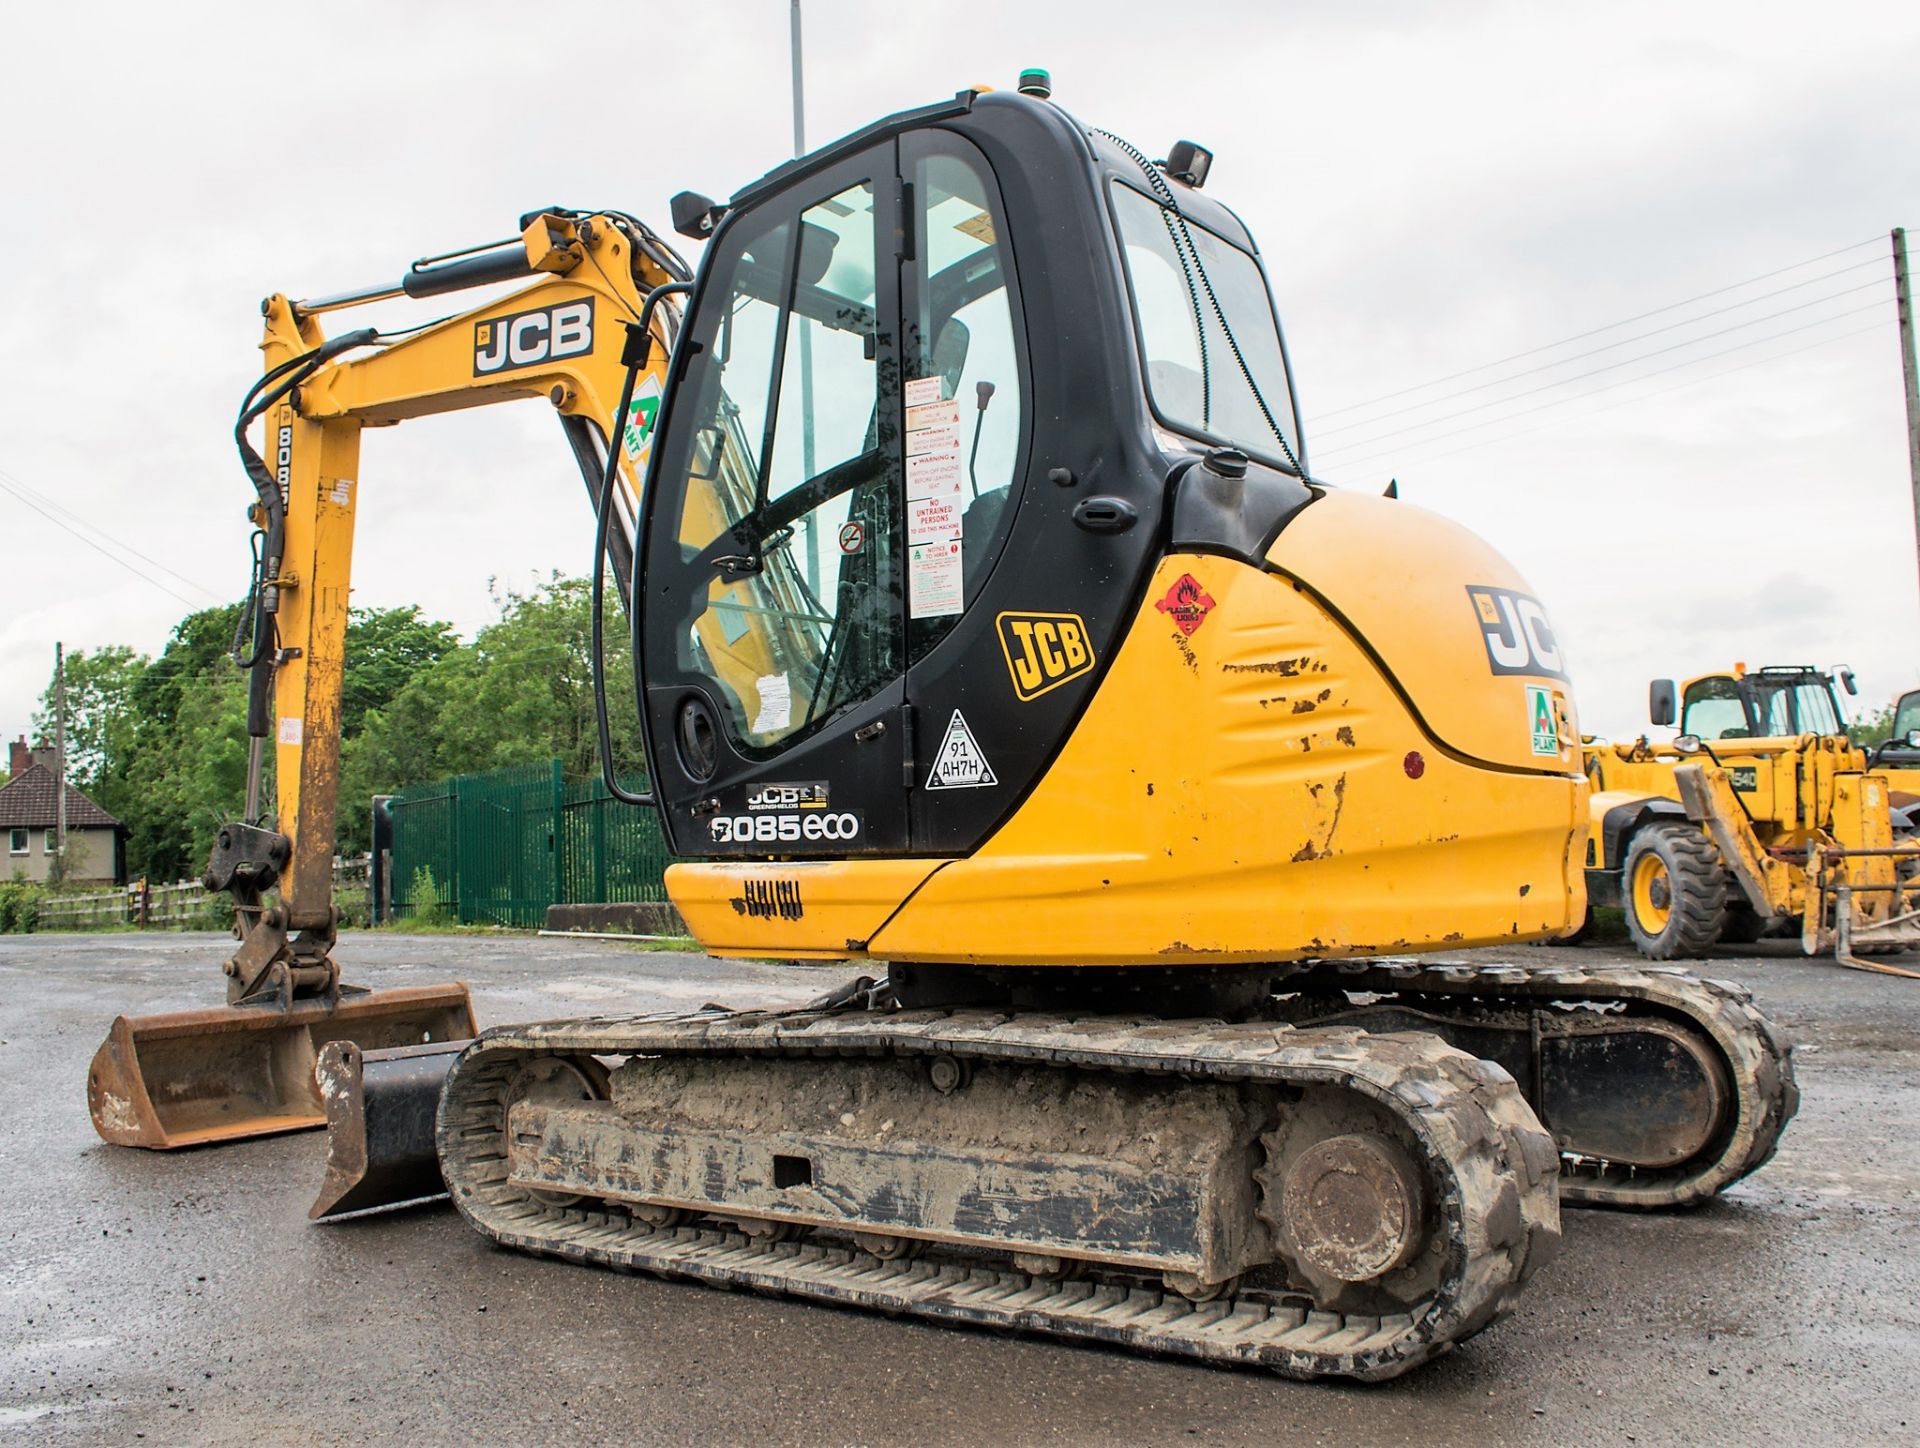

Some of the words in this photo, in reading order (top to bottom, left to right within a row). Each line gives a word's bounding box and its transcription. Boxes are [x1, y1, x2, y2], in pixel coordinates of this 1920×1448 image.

[476, 303, 592, 372] JCB
[919, 454, 949, 463] WARNING
[916, 505, 953, 518] UNTRAINED
[920, 514, 949, 525] PERSONS
[1487, 594, 1566, 672] JC
[1010, 621, 1087, 691] JCB
[950, 741, 968, 758] 91
[1533, 736, 1557, 752] PLANT
[942, 759, 979, 778] AH7H
[748, 803, 799, 811] GREENSHIELDS
